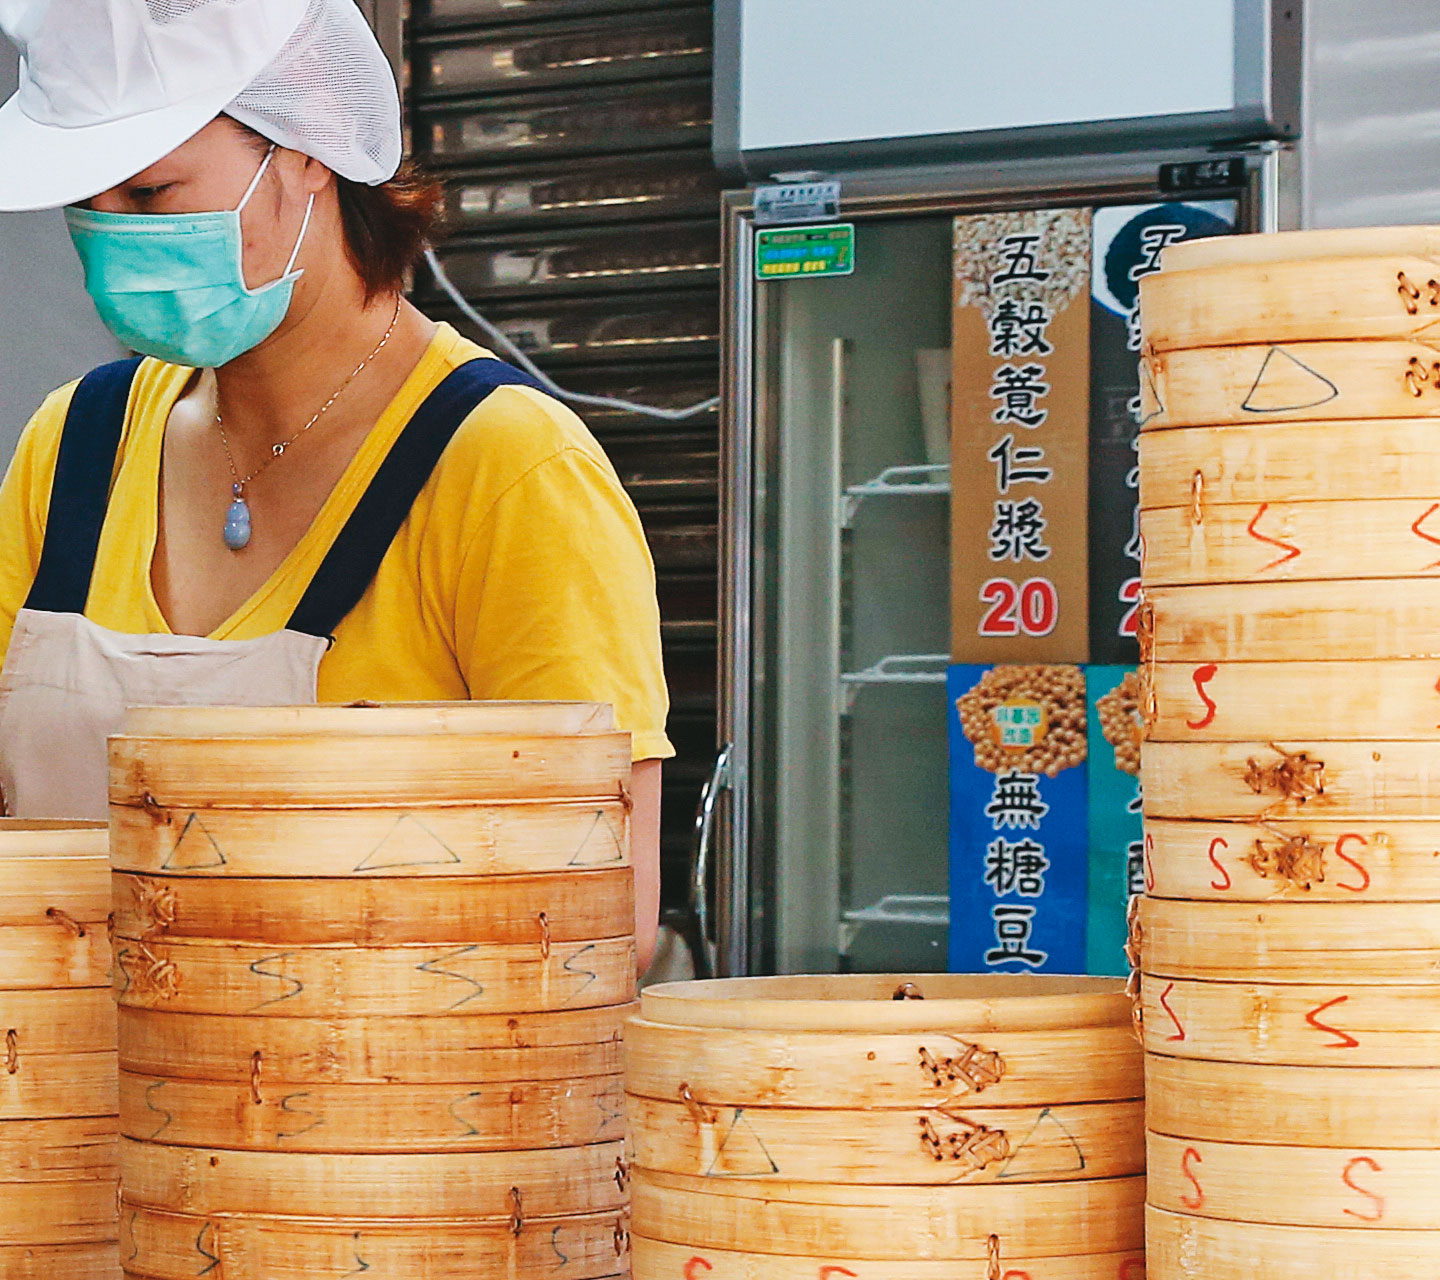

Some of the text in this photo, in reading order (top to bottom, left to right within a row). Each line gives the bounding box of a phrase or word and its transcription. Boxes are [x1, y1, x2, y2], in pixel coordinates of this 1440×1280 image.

[989, 232, 1052, 563] 五穀薏仁漿
[978, 577, 1061, 638] 20
[984, 770, 1051, 974] 無糖豆
